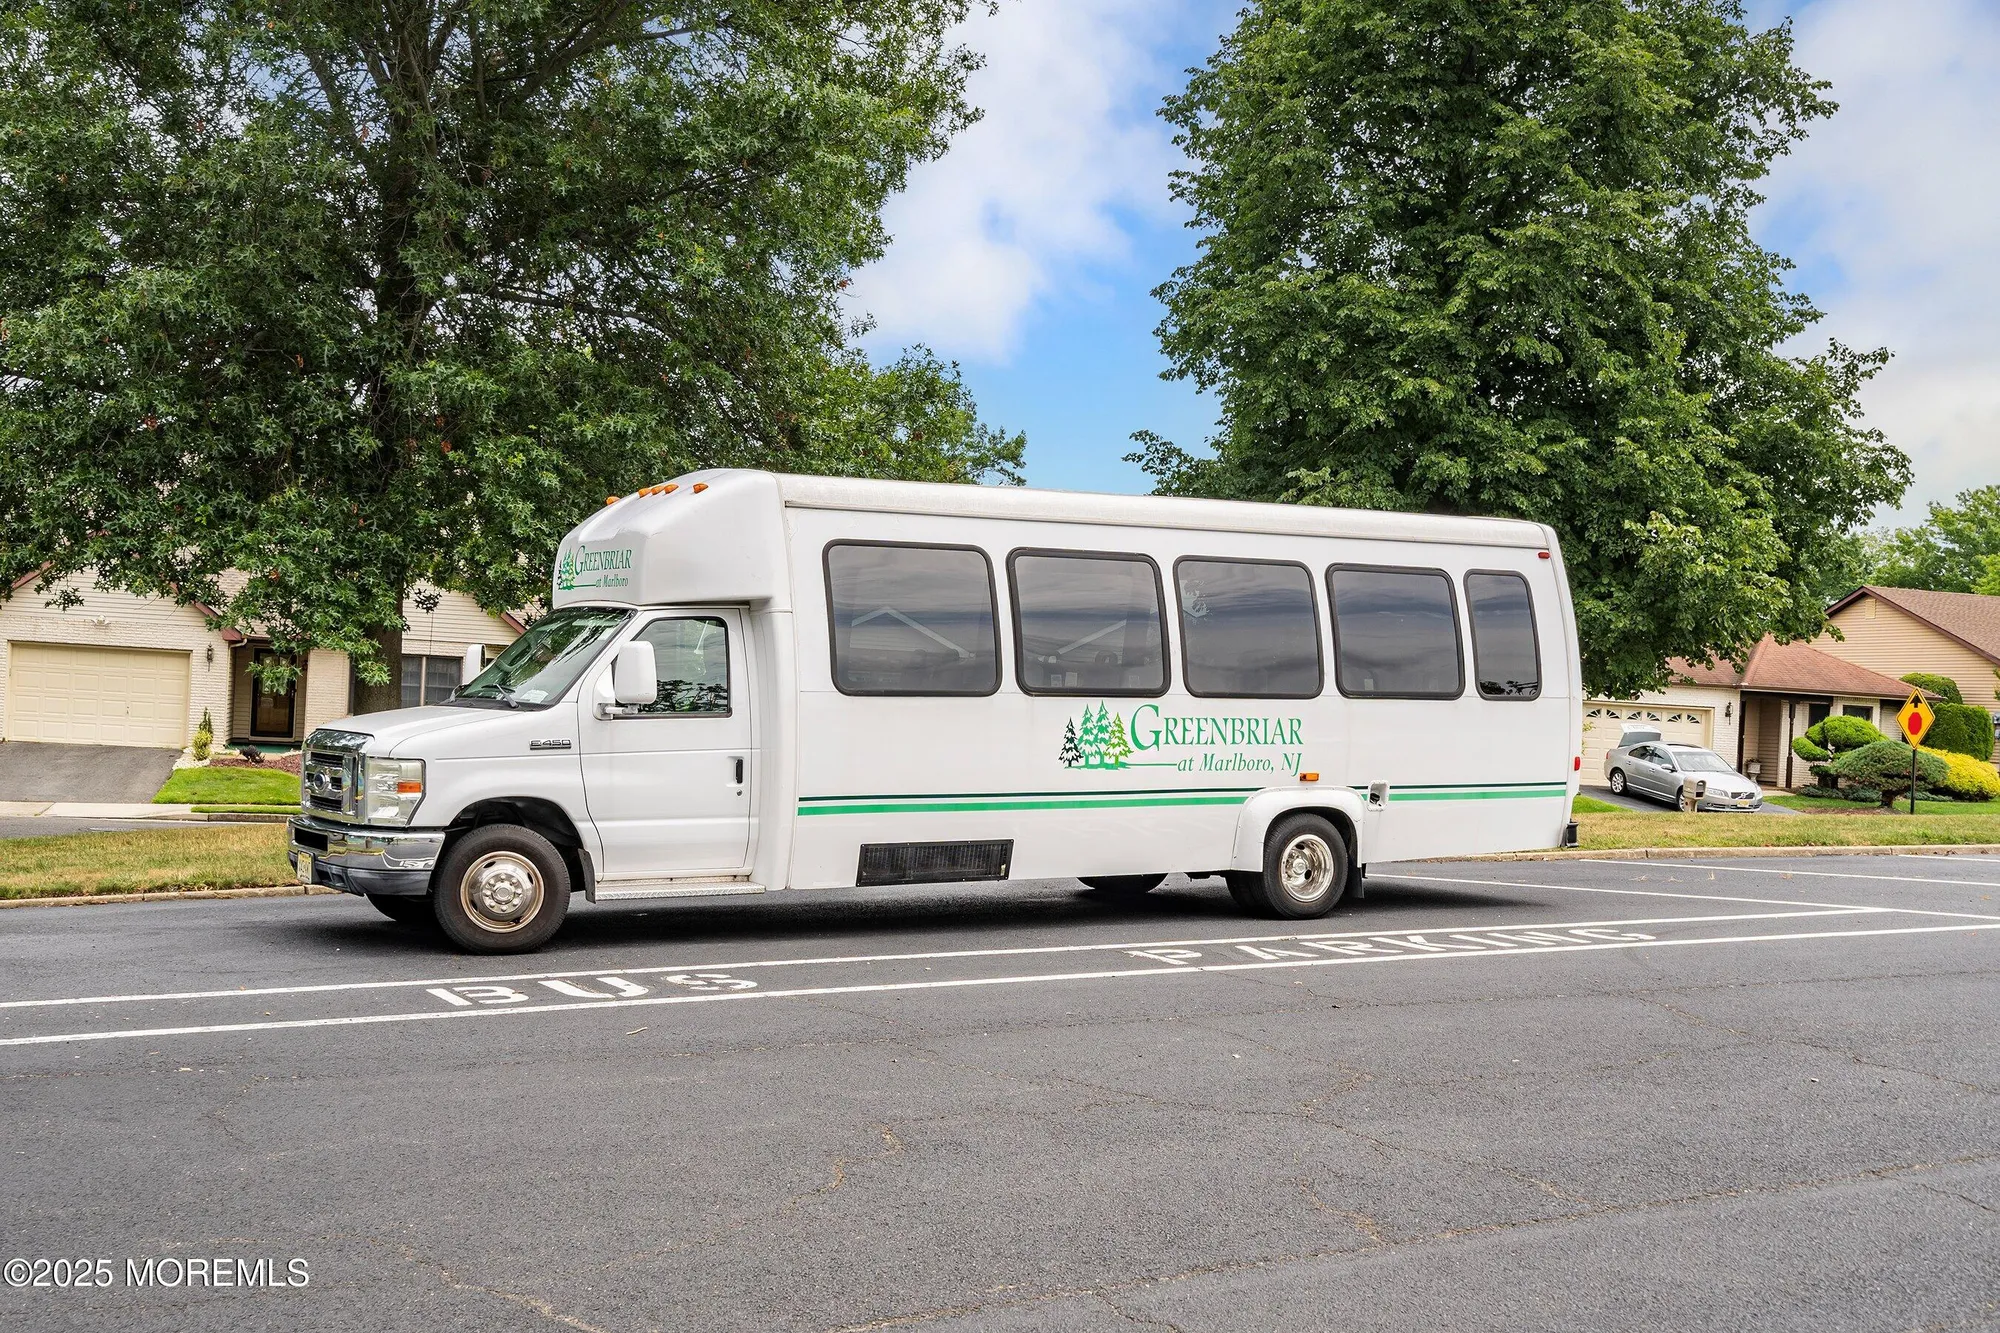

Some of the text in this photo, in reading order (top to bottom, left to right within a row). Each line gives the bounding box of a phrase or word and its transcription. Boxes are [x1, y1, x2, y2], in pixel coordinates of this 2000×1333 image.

[574, 545, 632, 576] GREENBRIAR
[595, 575, 629, 588] at Marlboro
[1130, 704, 1304, 751] GREENBRIAR
[1177, 752, 1302, 776] at Marlboro, NJ
[426, 928, 1657, 1006] BUS PARKING
